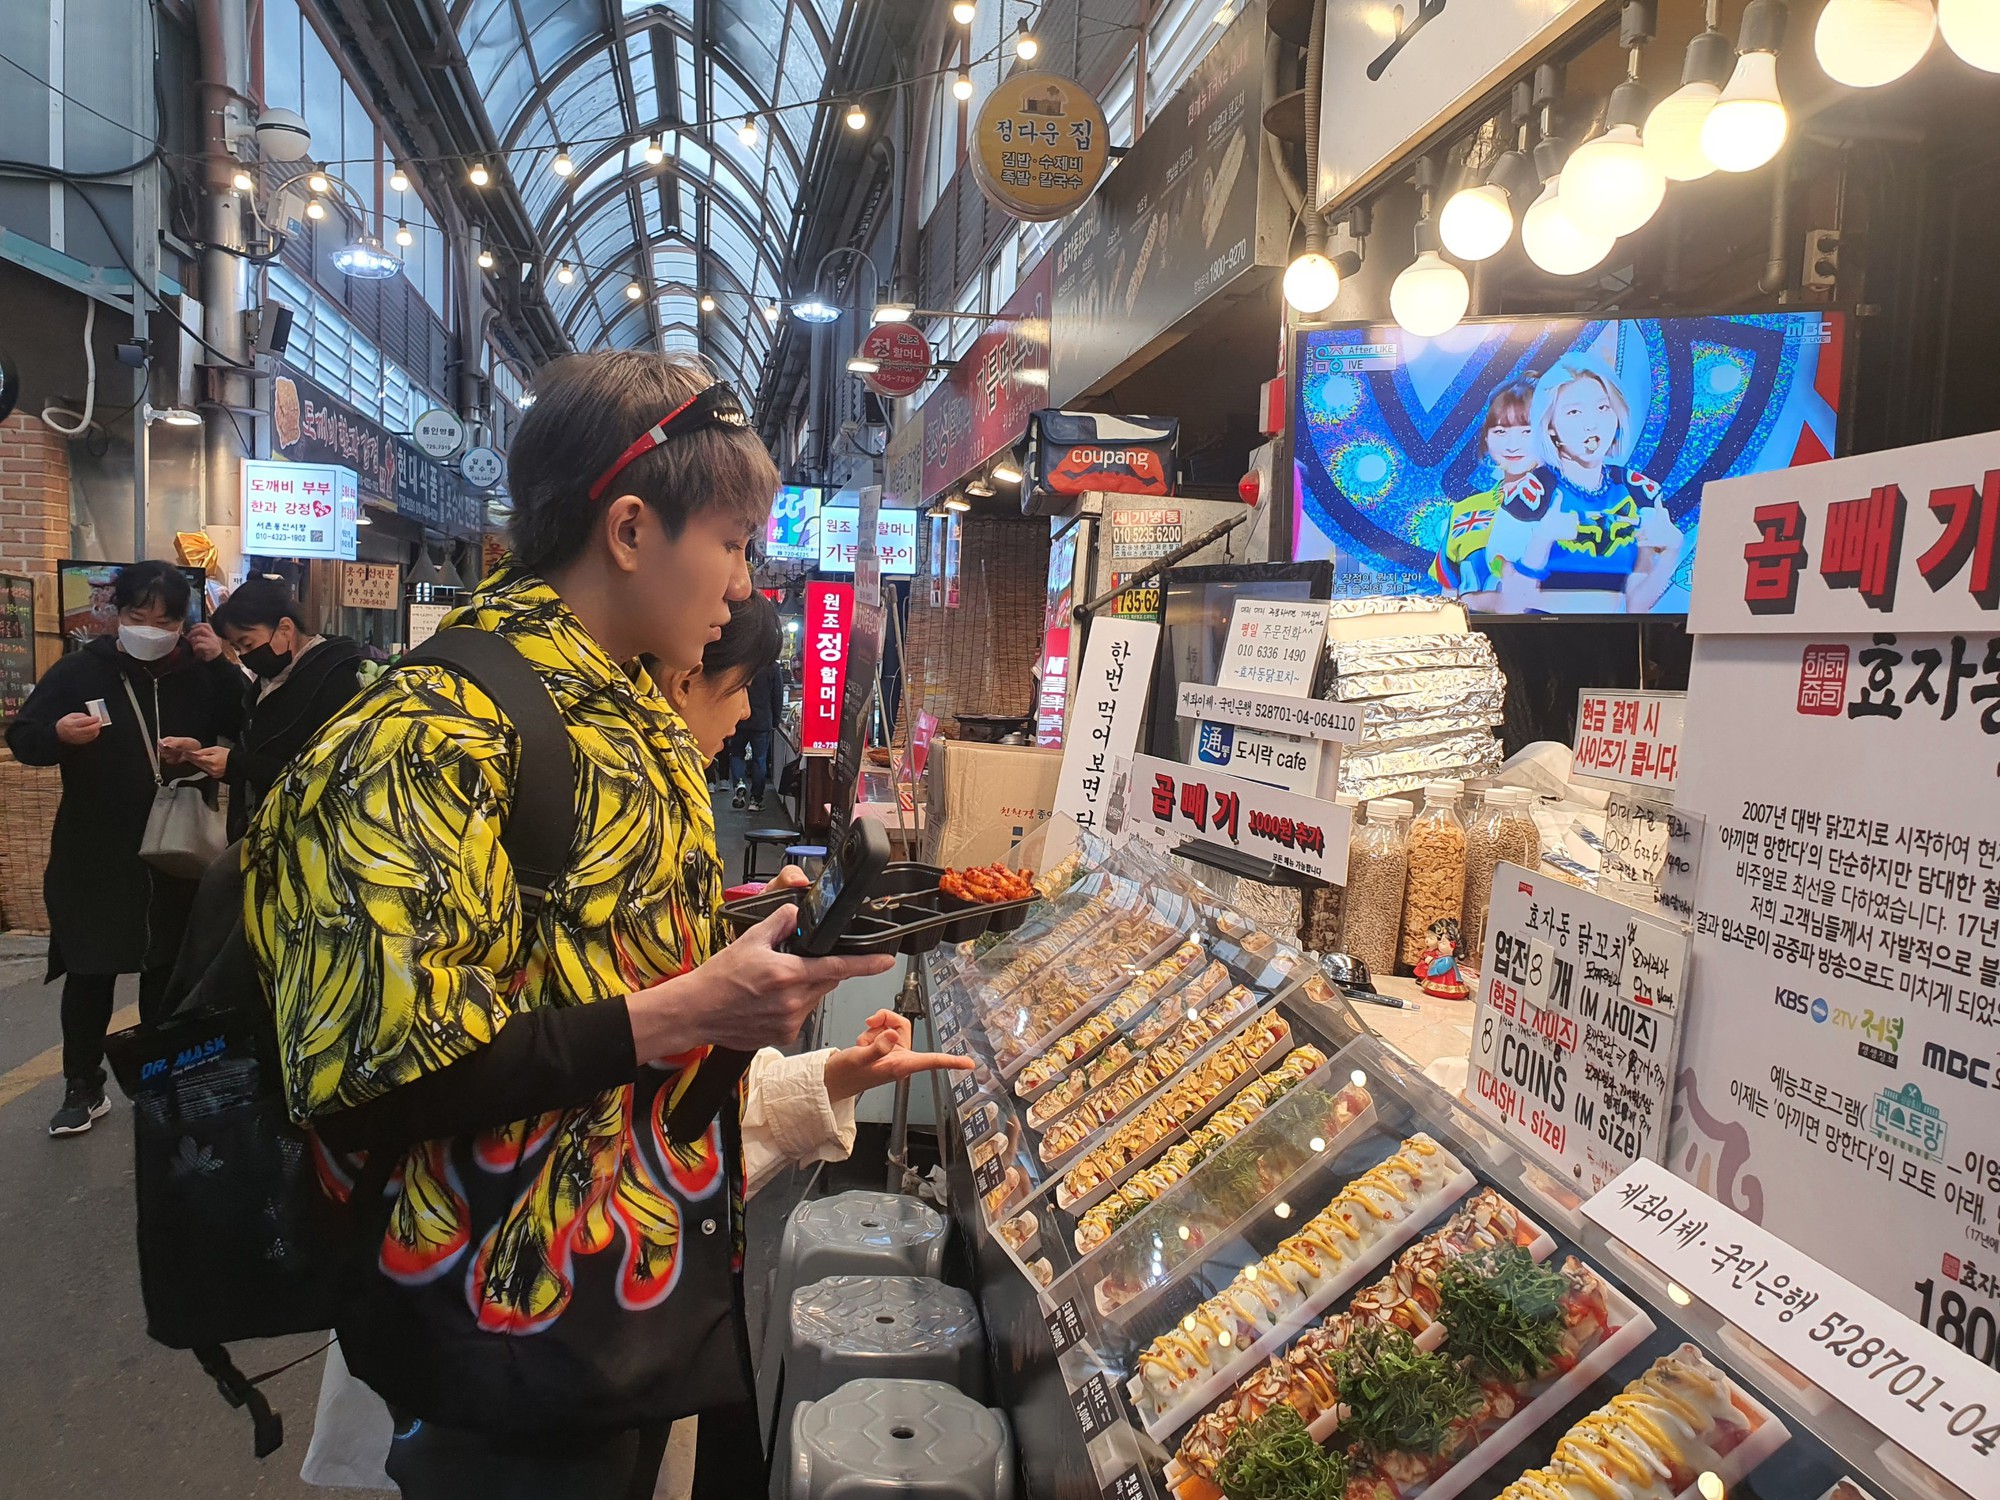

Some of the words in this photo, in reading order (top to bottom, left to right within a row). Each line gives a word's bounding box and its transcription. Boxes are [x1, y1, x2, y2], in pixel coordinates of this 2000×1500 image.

[995, 119, 1060, 146] 정다운
[1068, 119, 1092, 150] 집
[1208, 237, 1247, 284] 1800-9270
[897, 332, 920, 346] 원조
[1785, 322, 1833, 336] MBC
[871, 337, 891, 358] 정
[892, 346, 924, 361] 할머니
[1348, 360, 1364, 369] IVE
[1375, 345, 1394, 353] LIKE
[876, 373, 916, 384] 735-7289
[397, 446, 438, 505] 현대식품
[1072, 449, 1150, 470] coupang
[251, 480, 294, 494] 도깨비
[302, 481, 331, 496] 부부
[251, 500, 278, 514] 한과
[285, 502, 311, 516] 강정
[1114, 510, 1179, 524] 세기냉동
[256, 532, 307, 542] 010-4323-1902
[826, 519, 852, 533] 원조
[877, 521, 914, 537] 할머니
[1744, 468, 2000, 615] 곱빼기
[826, 543, 913, 566] 기름볶이
[1342, 572, 1373, 584] 장점이
[1377, 572, 1397, 583] 뭔지
[1401, 572, 1423, 584] 알아
[1351, 584, 1383, 595] 솔직한
[1386, 583, 1408, 594] 거야
[821, 593, 841, 629] 원조
[816, 632, 842, 662] 정
[1240, 622, 1259, 638] 평일
[1237, 644, 1254, 657] 010
[1256, 645, 1279, 660] 6336
[1283, 648, 1307, 662] 1490
[819, 665, 839, 721] 할머니
[1218, 697, 1252, 717] 국민은행
[1254, 703, 1357, 732] 528701-04-064110
[1582, 698, 1607, 732] 현금
[1611, 700, 1640, 735] 결제
[1643, 701, 1661, 738] 시
[1235, 740, 1274, 767] 도시락
[1276, 751, 1307, 771] cafe
[1576, 735, 1628, 774] 사이즈가
[1630, 740, 1679, 782] 큽니다.
[1152, 772, 1240, 845] 곱빼기
[1248, 810, 1295, 849] 1000원
[1295, 821, 1325, 859] 추가
[1610, 802, 1631, 820] 미리
[1632, 804, 1656, 836] 주문
[1742, 800, 1788, 830] 2007년
[1790, 807, 1822, 837] 대박
[1826, 813, 1890, 847] 닭꼬치로
[1894, 825, 1972, 865] 시작하여
[1977, 838, 2000, 870] 현
[1272, 852, 1283, 863] 모든
[1283, 856, 1295, 867] 메뉴
[1295, 859, 1322, 876] 가능합니다
[1828, 846, 1913, 890] 단순하지만
[1917, 865, 1977, 904] 담대한
[1736, 860, 1788, 892] 비주얼로
[1791, 873, 1837, 907] 최선을
[1841, 883, 1948, 935] 다하였습니다.
[1957, 912, 2000, 949] 17년
[1525, 902, 1571, 947] 효자동
[1578, 921, 1628, 978] 닭꼬치
[1749, 895, 1778, 925] 저희
[1779, 902, 1874, 953] 고객님들께서
[1878, 928, 1973, 978] 자발적으로
[1493, 930, 1531, 986] 엽전
[1529, 953, 1543, 986] 8
[1696, 910, 1720, 938] 결과
[1721, 918, 1770, 956] 입소문이
[1772, 932, 1816, 970] 공중파
[1817, 946, 1896, 991] 방송으로도
[1899, 971, 1954, 1014] 미치게
[1488, 977, 1518, 1019] (현금
[1519, 998, 1528, 1025] L
[1531, 1009, 1579, 1053] 사이즈)
[1549, 957, 1574, 1010] 개
[1580, 985, 1599, 1021] (M
[1602, 997, 1658, 1053] 사이즈)
[1774, 985, 1810, 1016] KBS
[1831, 1006, 1858, 1031] 2TV
[1860, 1008, 1905, 1053] 저녁
[1481, 1017, 1494, 1054] 8
[142, 1059, 169, 1080] DR.
[174, 1035, 227, 1068] MASK
[1922, 1041, 1991, 1089] MBC
[1477, 1069, 1517, 1118] (CASH
[1518, 1096, 1527, 1126] L
[1531, 1110, 1566, 1154] size)
[1501, 1034, 1568, 1113] COINS
[1574, 1092, 1595, 1131] (M
[1598, 1113, 1643, 1161] size)
[1730, 1079, 1769, 1119] 이제는
[1898, 1160, 1937, 1199] 모토
[1050, 1321, 1066, 1350] 6,000원
[1914, 1277, 2000, 1374] 180
[1710, 1242, 1819, 1324] 국민은행
[1807, 1310, 2000, 1457] 528701-04
[1088, 1375, 1107, 1410] 와인치즈
[1076, 1400, 1095, 1433] 5,000원
